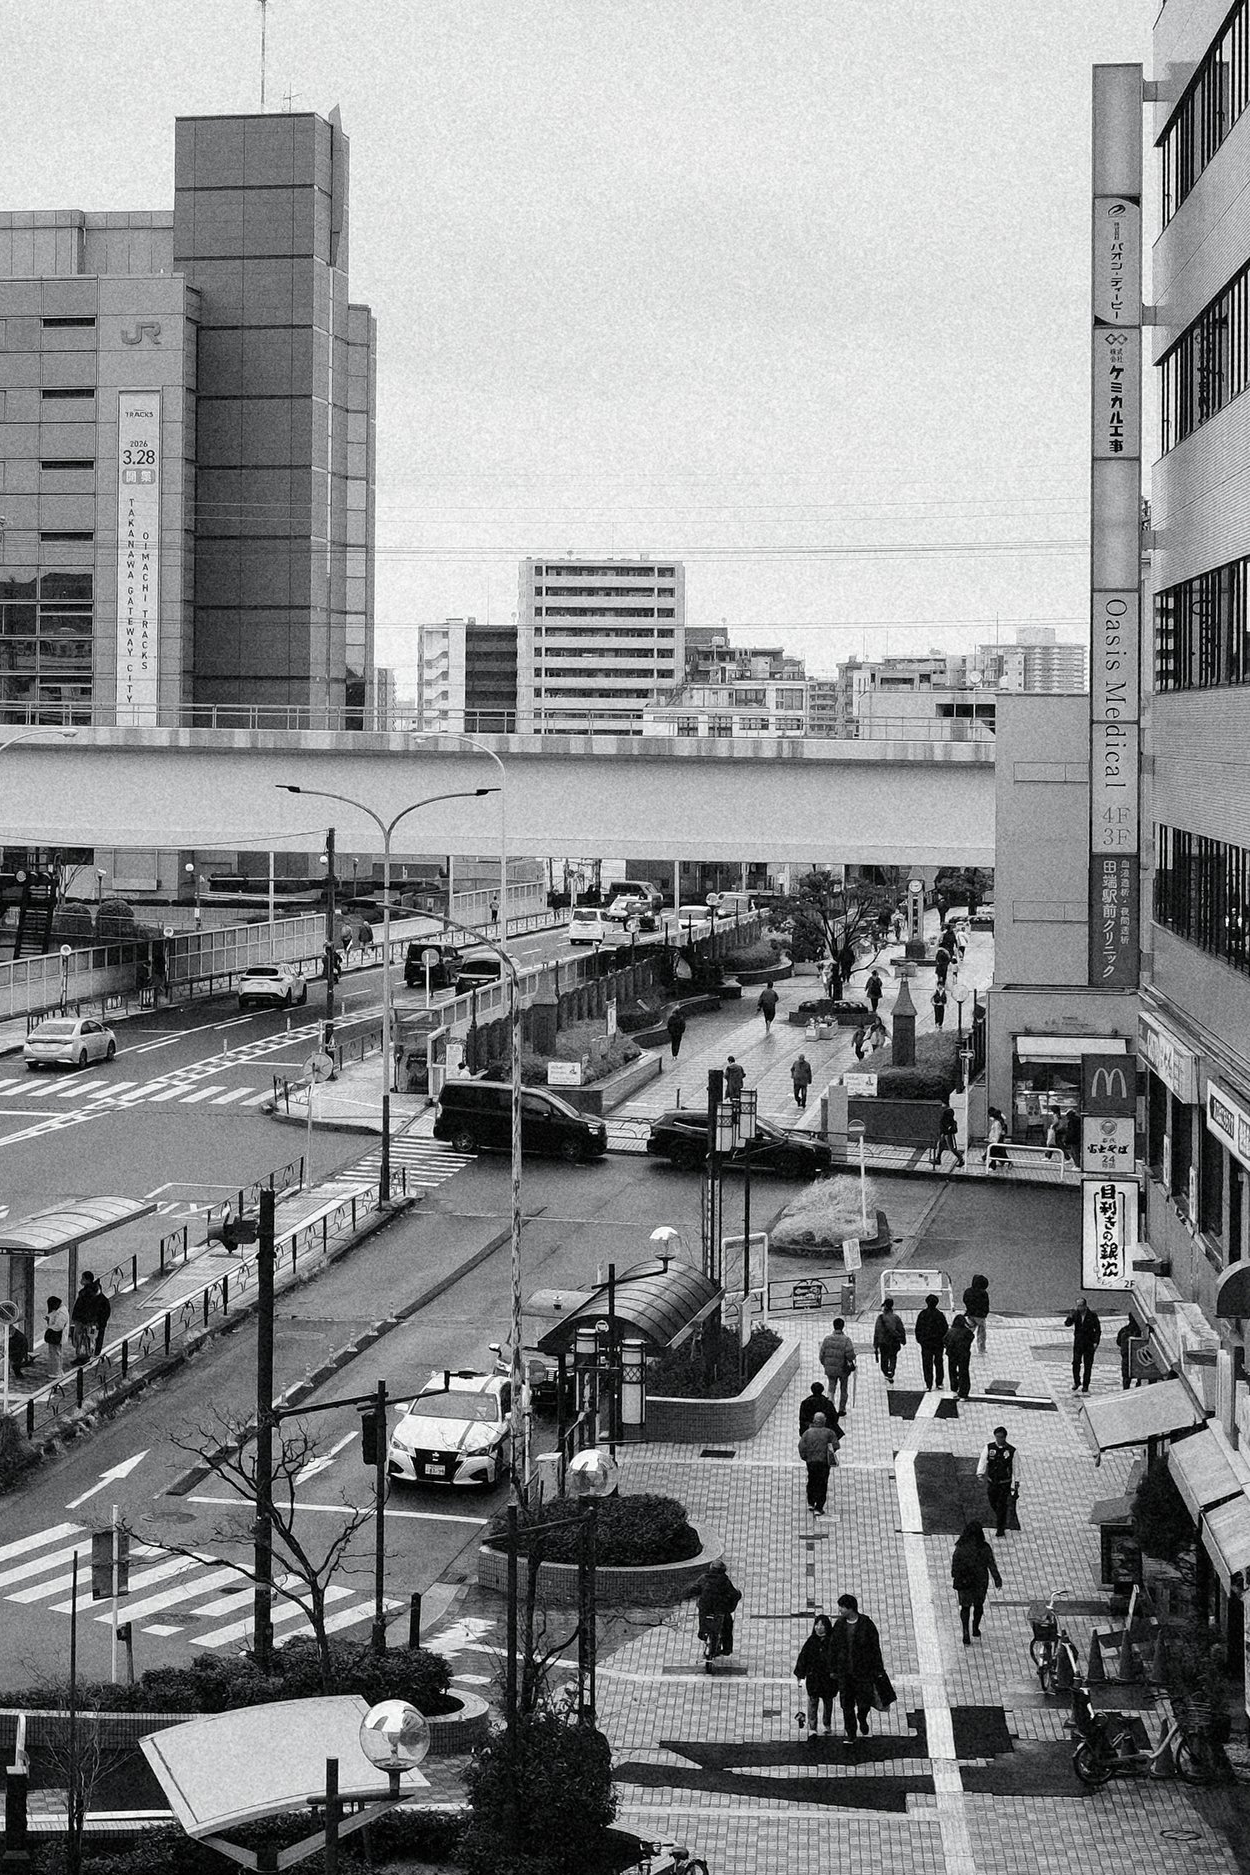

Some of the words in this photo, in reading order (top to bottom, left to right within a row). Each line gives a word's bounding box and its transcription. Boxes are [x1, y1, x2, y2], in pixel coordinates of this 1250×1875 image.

[120, 321, 162, 345] JR
[129, 440, 149, 448] 2026
[1109, 364, 1125, 453] ケミカル工事
[122, 450, 156, 465] 3.28
[127, 499, 135, 579] TAKANAWA
[142, 532, 150, 602] OIMACHI
[126, 586, 134, 657] GATEWAY
[1105, 599, 1128, 671] Oasis
[1105, 680, 1127, 788] Medical
[1102, 806, 1131, 824] 4F
[1102, 828, 1131, 846] 3F
[1101, 860, 1118, 978] 田端駅前クリニック
[1099, 1183, 1119, 1277] 目利きの銀次
